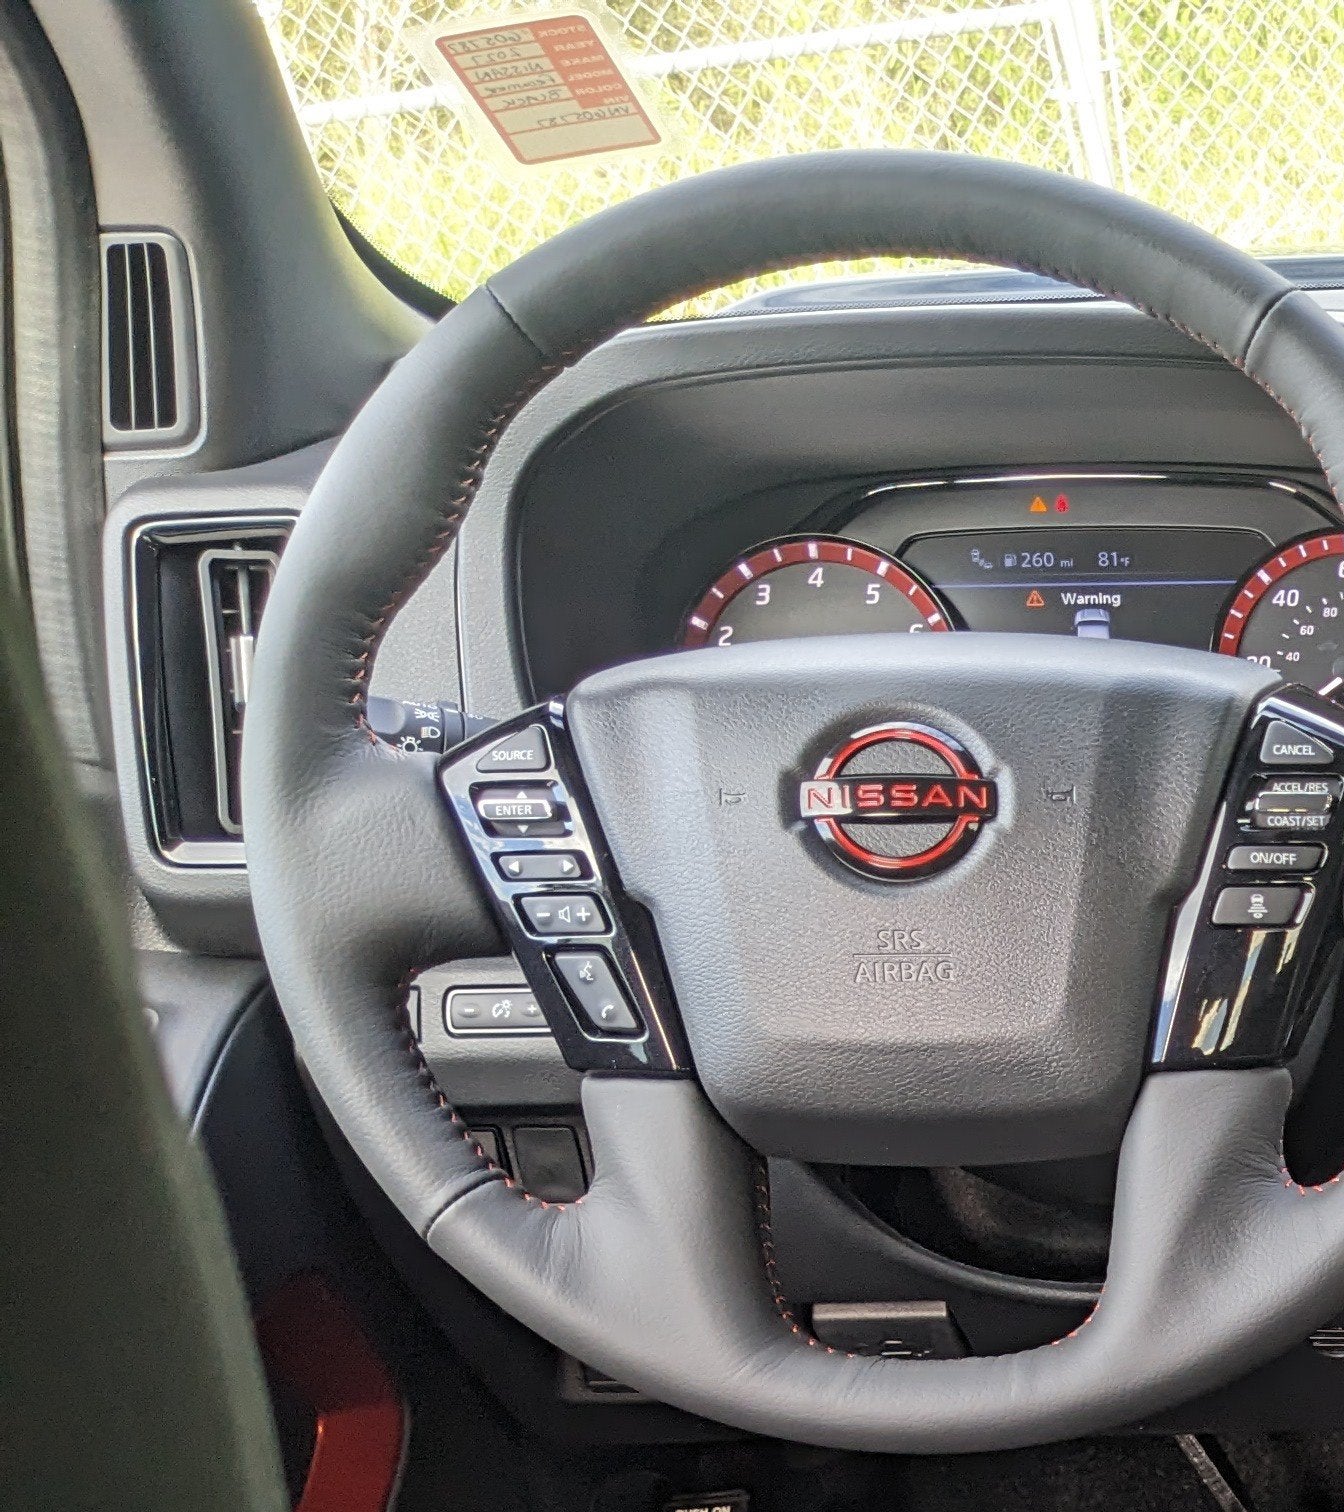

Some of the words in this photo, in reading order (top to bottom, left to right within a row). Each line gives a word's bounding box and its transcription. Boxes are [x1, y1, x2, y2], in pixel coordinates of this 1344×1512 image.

[1021, 552, 1054, 568] 260
[808, 567, 824, 588] 4
[756, 584, 771, 605] 3
[865, 583, 880, 604] 5
[1060, 592, 1122, 608] Warning
[1272, 589, 1300, 607] 40
[1323, 607, 1337, 617] 80
[718, 626, 734, 647] 2
[1300, 626, 1314, 635] 60
[1286, 652, 1300, 661] 40
[492, 750, 533, 761] SOURCE
[1273, 744, 1315, 756] CANCEL
[1272, 782, 1328, 792] ACCEL/RES
[807, 784, 987, 809] NISSAN
[495, 804, 532, 816] ENTER
[1267, 817, 1326, 827] COAST/SET
[1250, 852, 1297, 864] ON/OFF
[878, 929, 924, 950] SRS
[854, 960, 955, 983] AIRBAG
